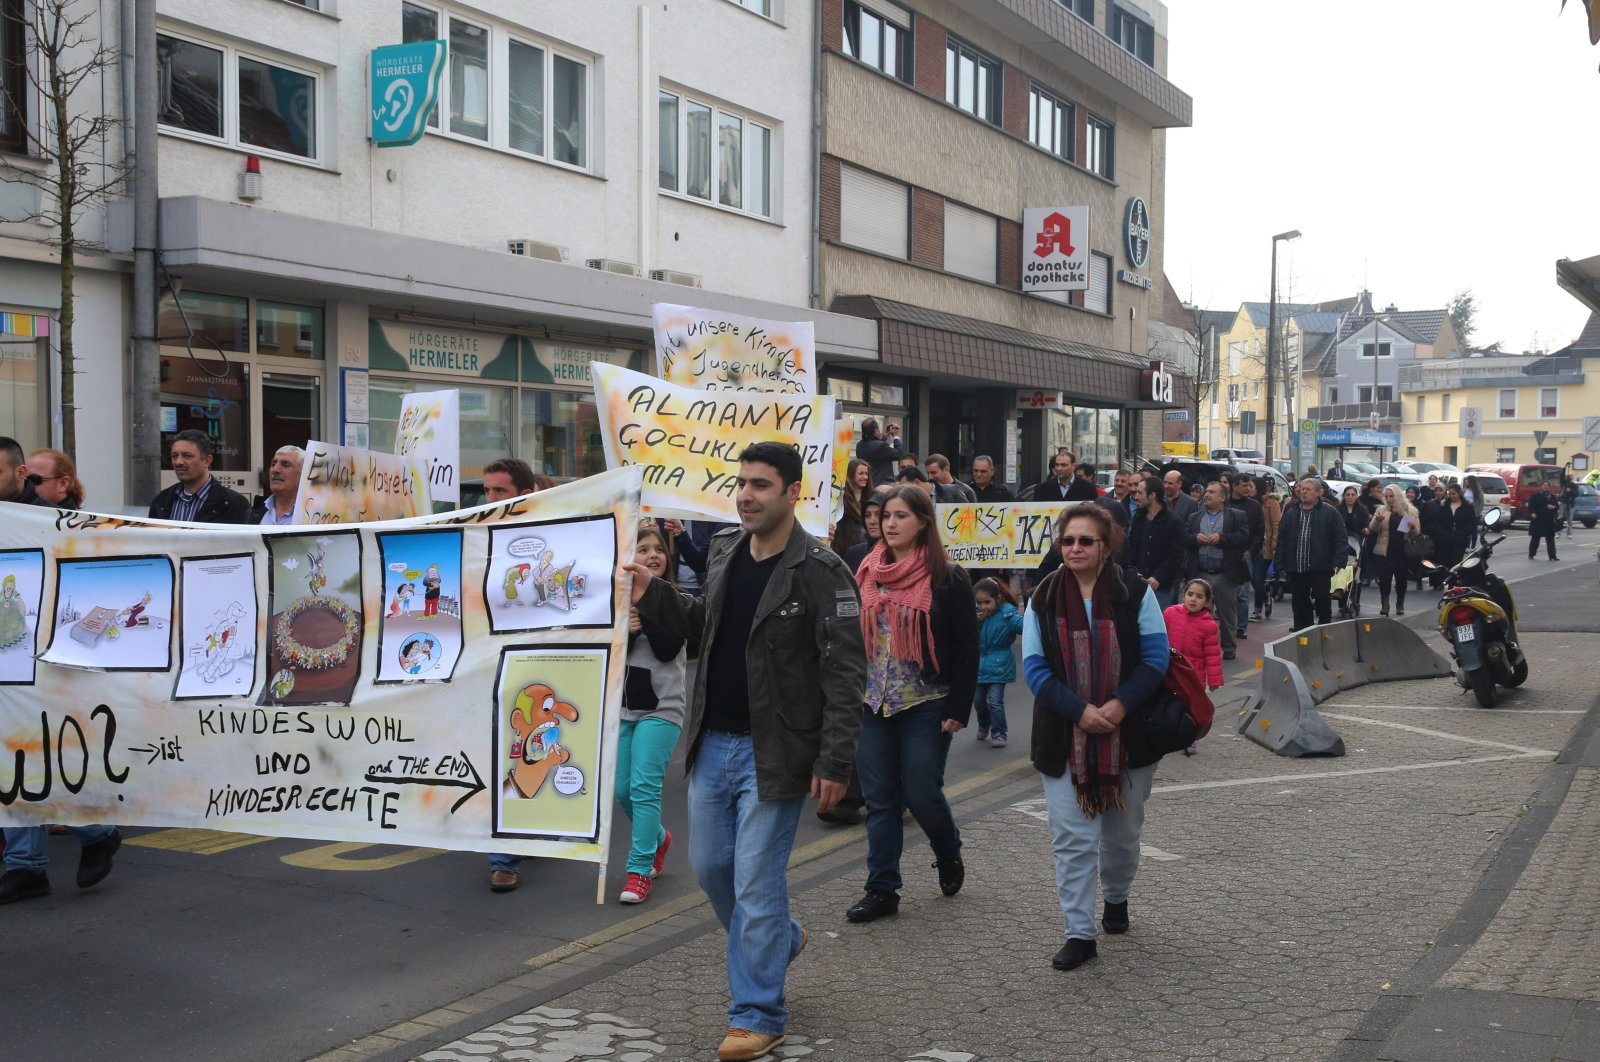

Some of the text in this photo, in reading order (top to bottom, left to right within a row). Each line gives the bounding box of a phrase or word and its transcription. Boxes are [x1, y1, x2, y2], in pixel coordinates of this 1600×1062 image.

[376, 64, 423, 77] HERMELER
[1130, 222, 1148, 240] BAYER
[1027, 260, 1082, 272] donatus
[1024, 272, 1085, 286] apotheke
[409, 330, 478, 352] HÖRGERÄTE
[687, 320, 739, 337] unsere
[744, 326, 806, 377] Kinder
[344, 345, 361, 361] 59
[409, 348, 478, 371] HERMELER
[186, 375, 238, 386] ZAHNARZTPRAXIS
[554, 365, 593, 381] HERME
[628, 386, 812, 433] ALMANYA
[307, 450, 414, 496] Evlat Hasreti
[159, 735, 184, 761] ist
[255, 752, 311, 775] UND
[398, 755, 428, 775] THE
[434, 755, 470, 778] END
